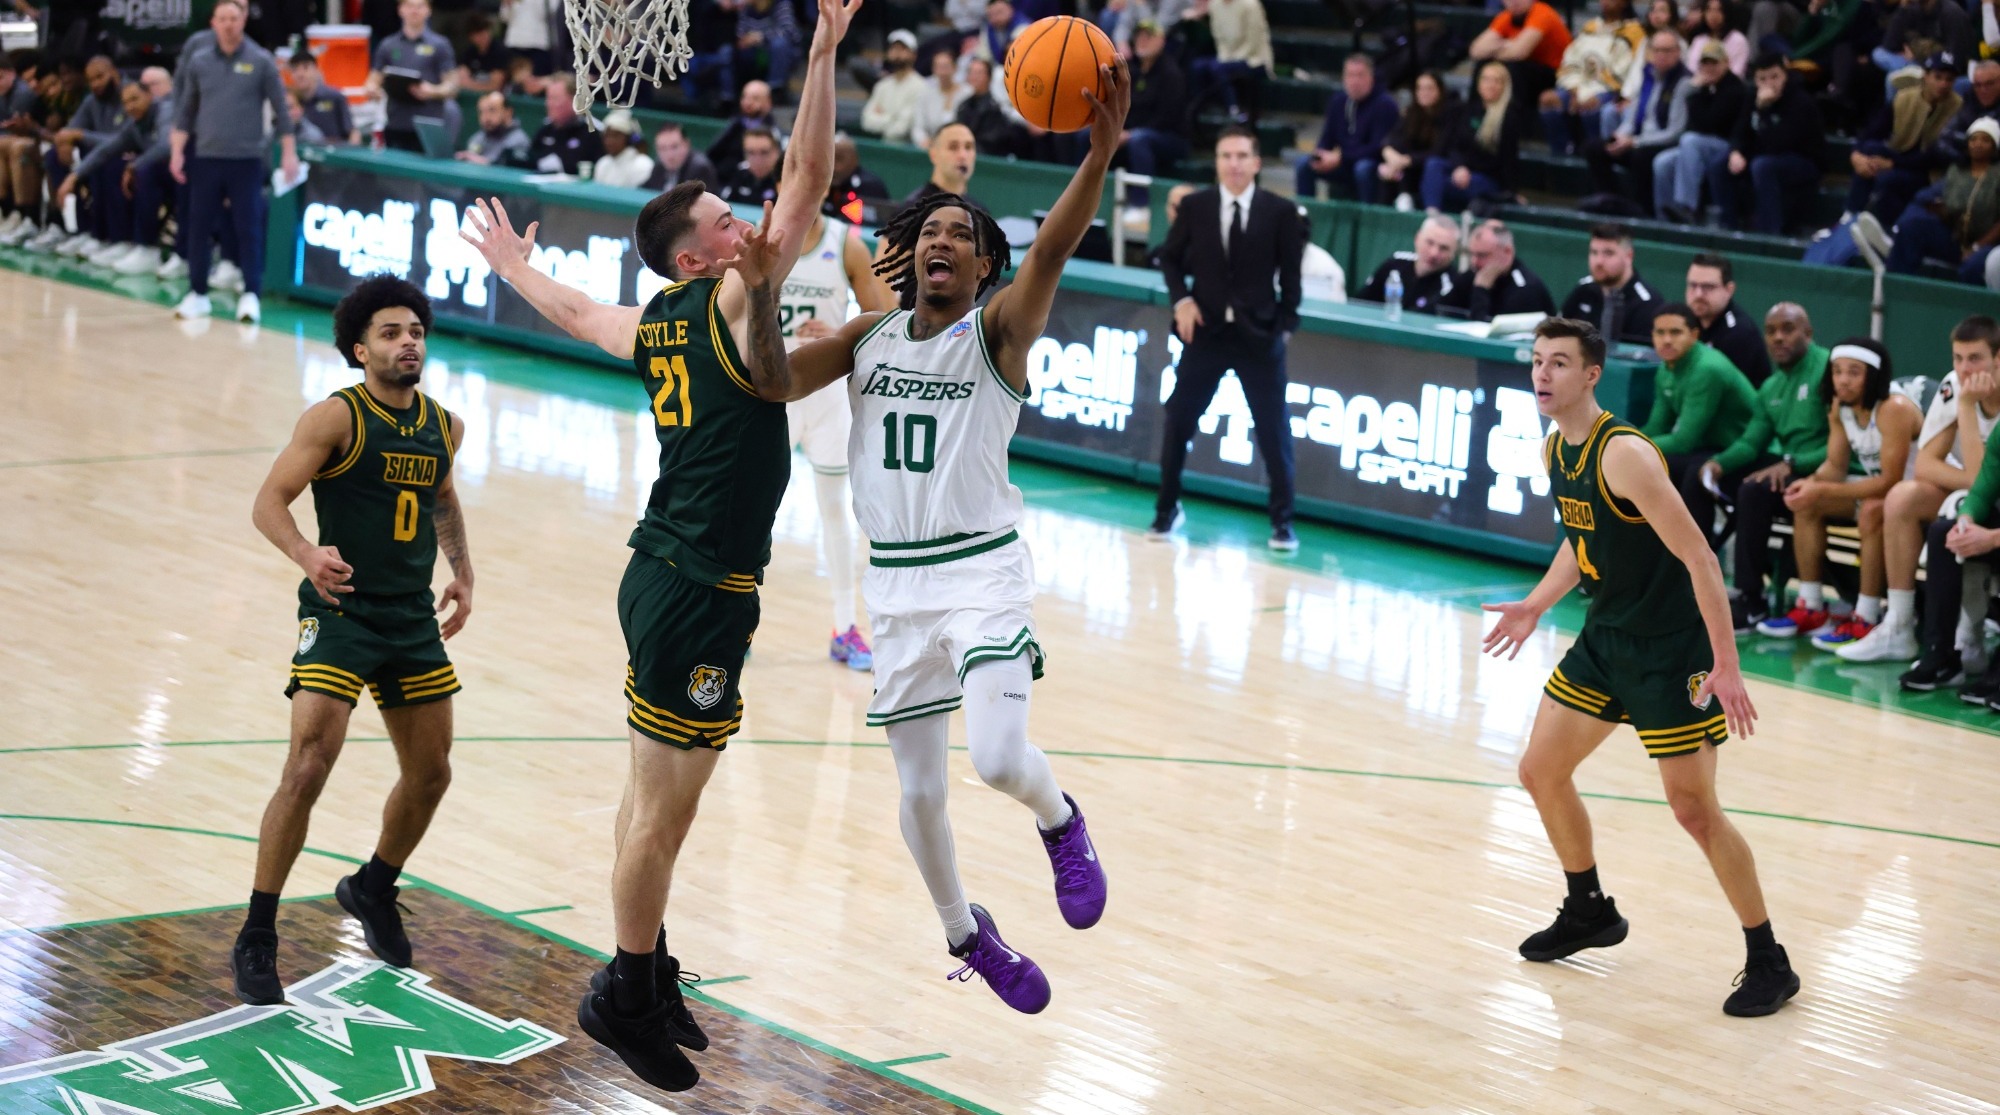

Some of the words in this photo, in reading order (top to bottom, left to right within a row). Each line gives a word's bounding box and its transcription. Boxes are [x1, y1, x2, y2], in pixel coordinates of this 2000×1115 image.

[649, 354, 693, 427] 21
[860, 362, 976, 401] JASPERS
[1041, 390, 1133, 431] SPORT
[882, 411, 938, 473] 10
[386, 456, 435, 484] SIENA
[1357, 452, 1467, 498] SPORT
[394, 489, 419, 541] 0
[1577, 535, 1601, 580] 4
